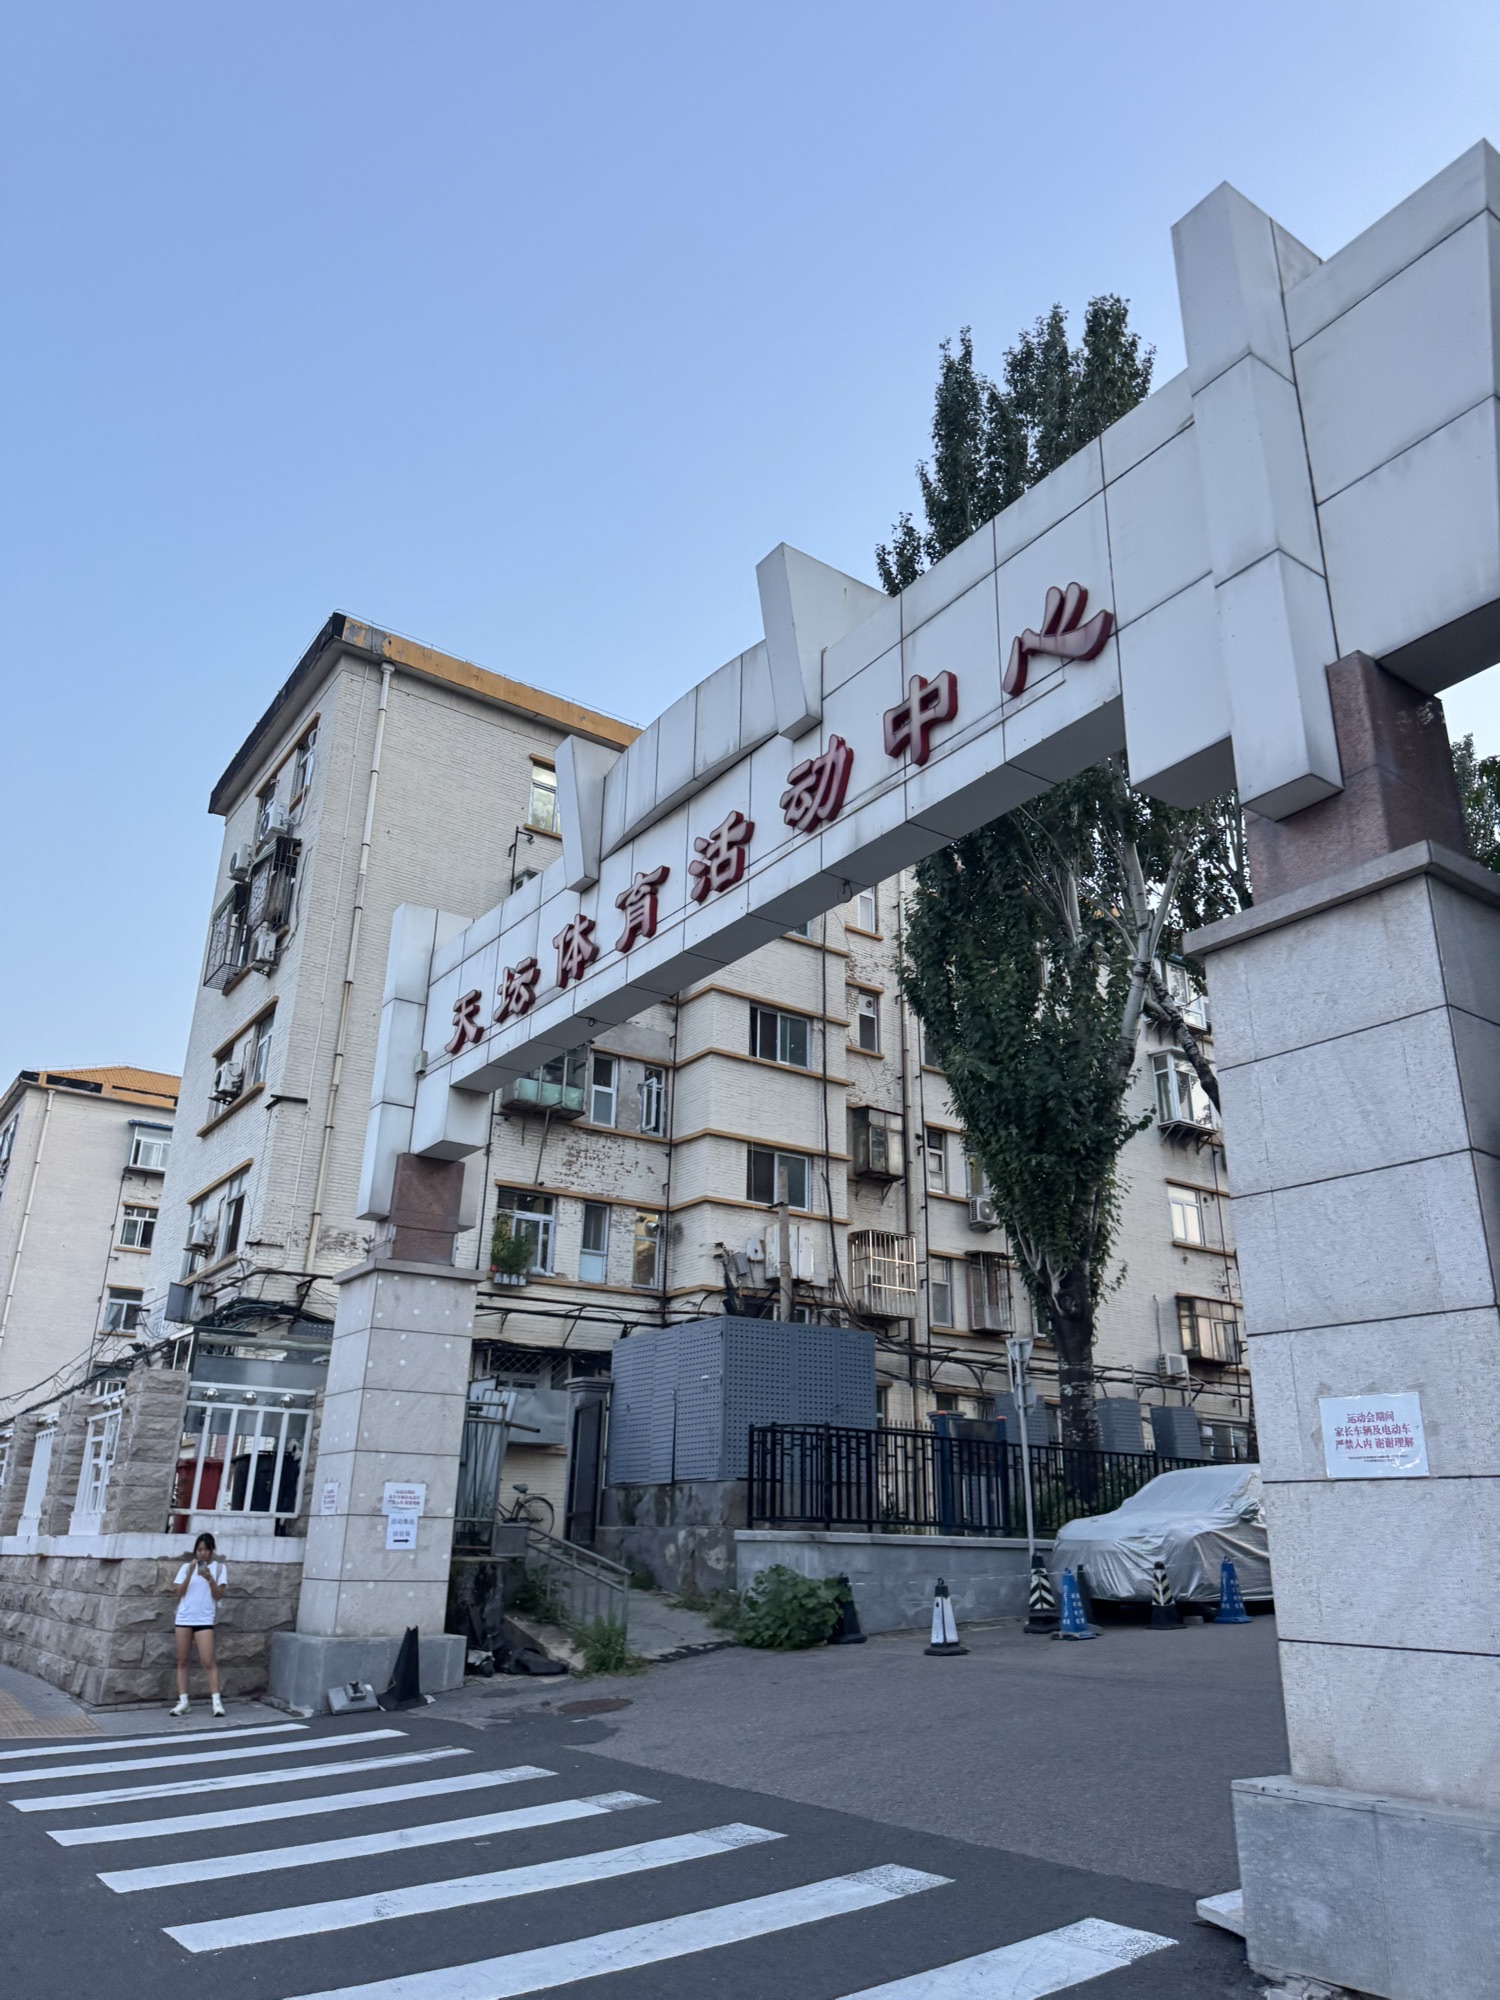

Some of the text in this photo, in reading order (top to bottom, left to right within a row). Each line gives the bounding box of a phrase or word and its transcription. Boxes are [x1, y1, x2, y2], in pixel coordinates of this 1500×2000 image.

[444, 581, 1114, 1054] 天坛体育活动中心
[1347, 1411, 1394, 1423] 运动会期间
[1334, 1423, 1411, 1437] 家长车辆及电动车
